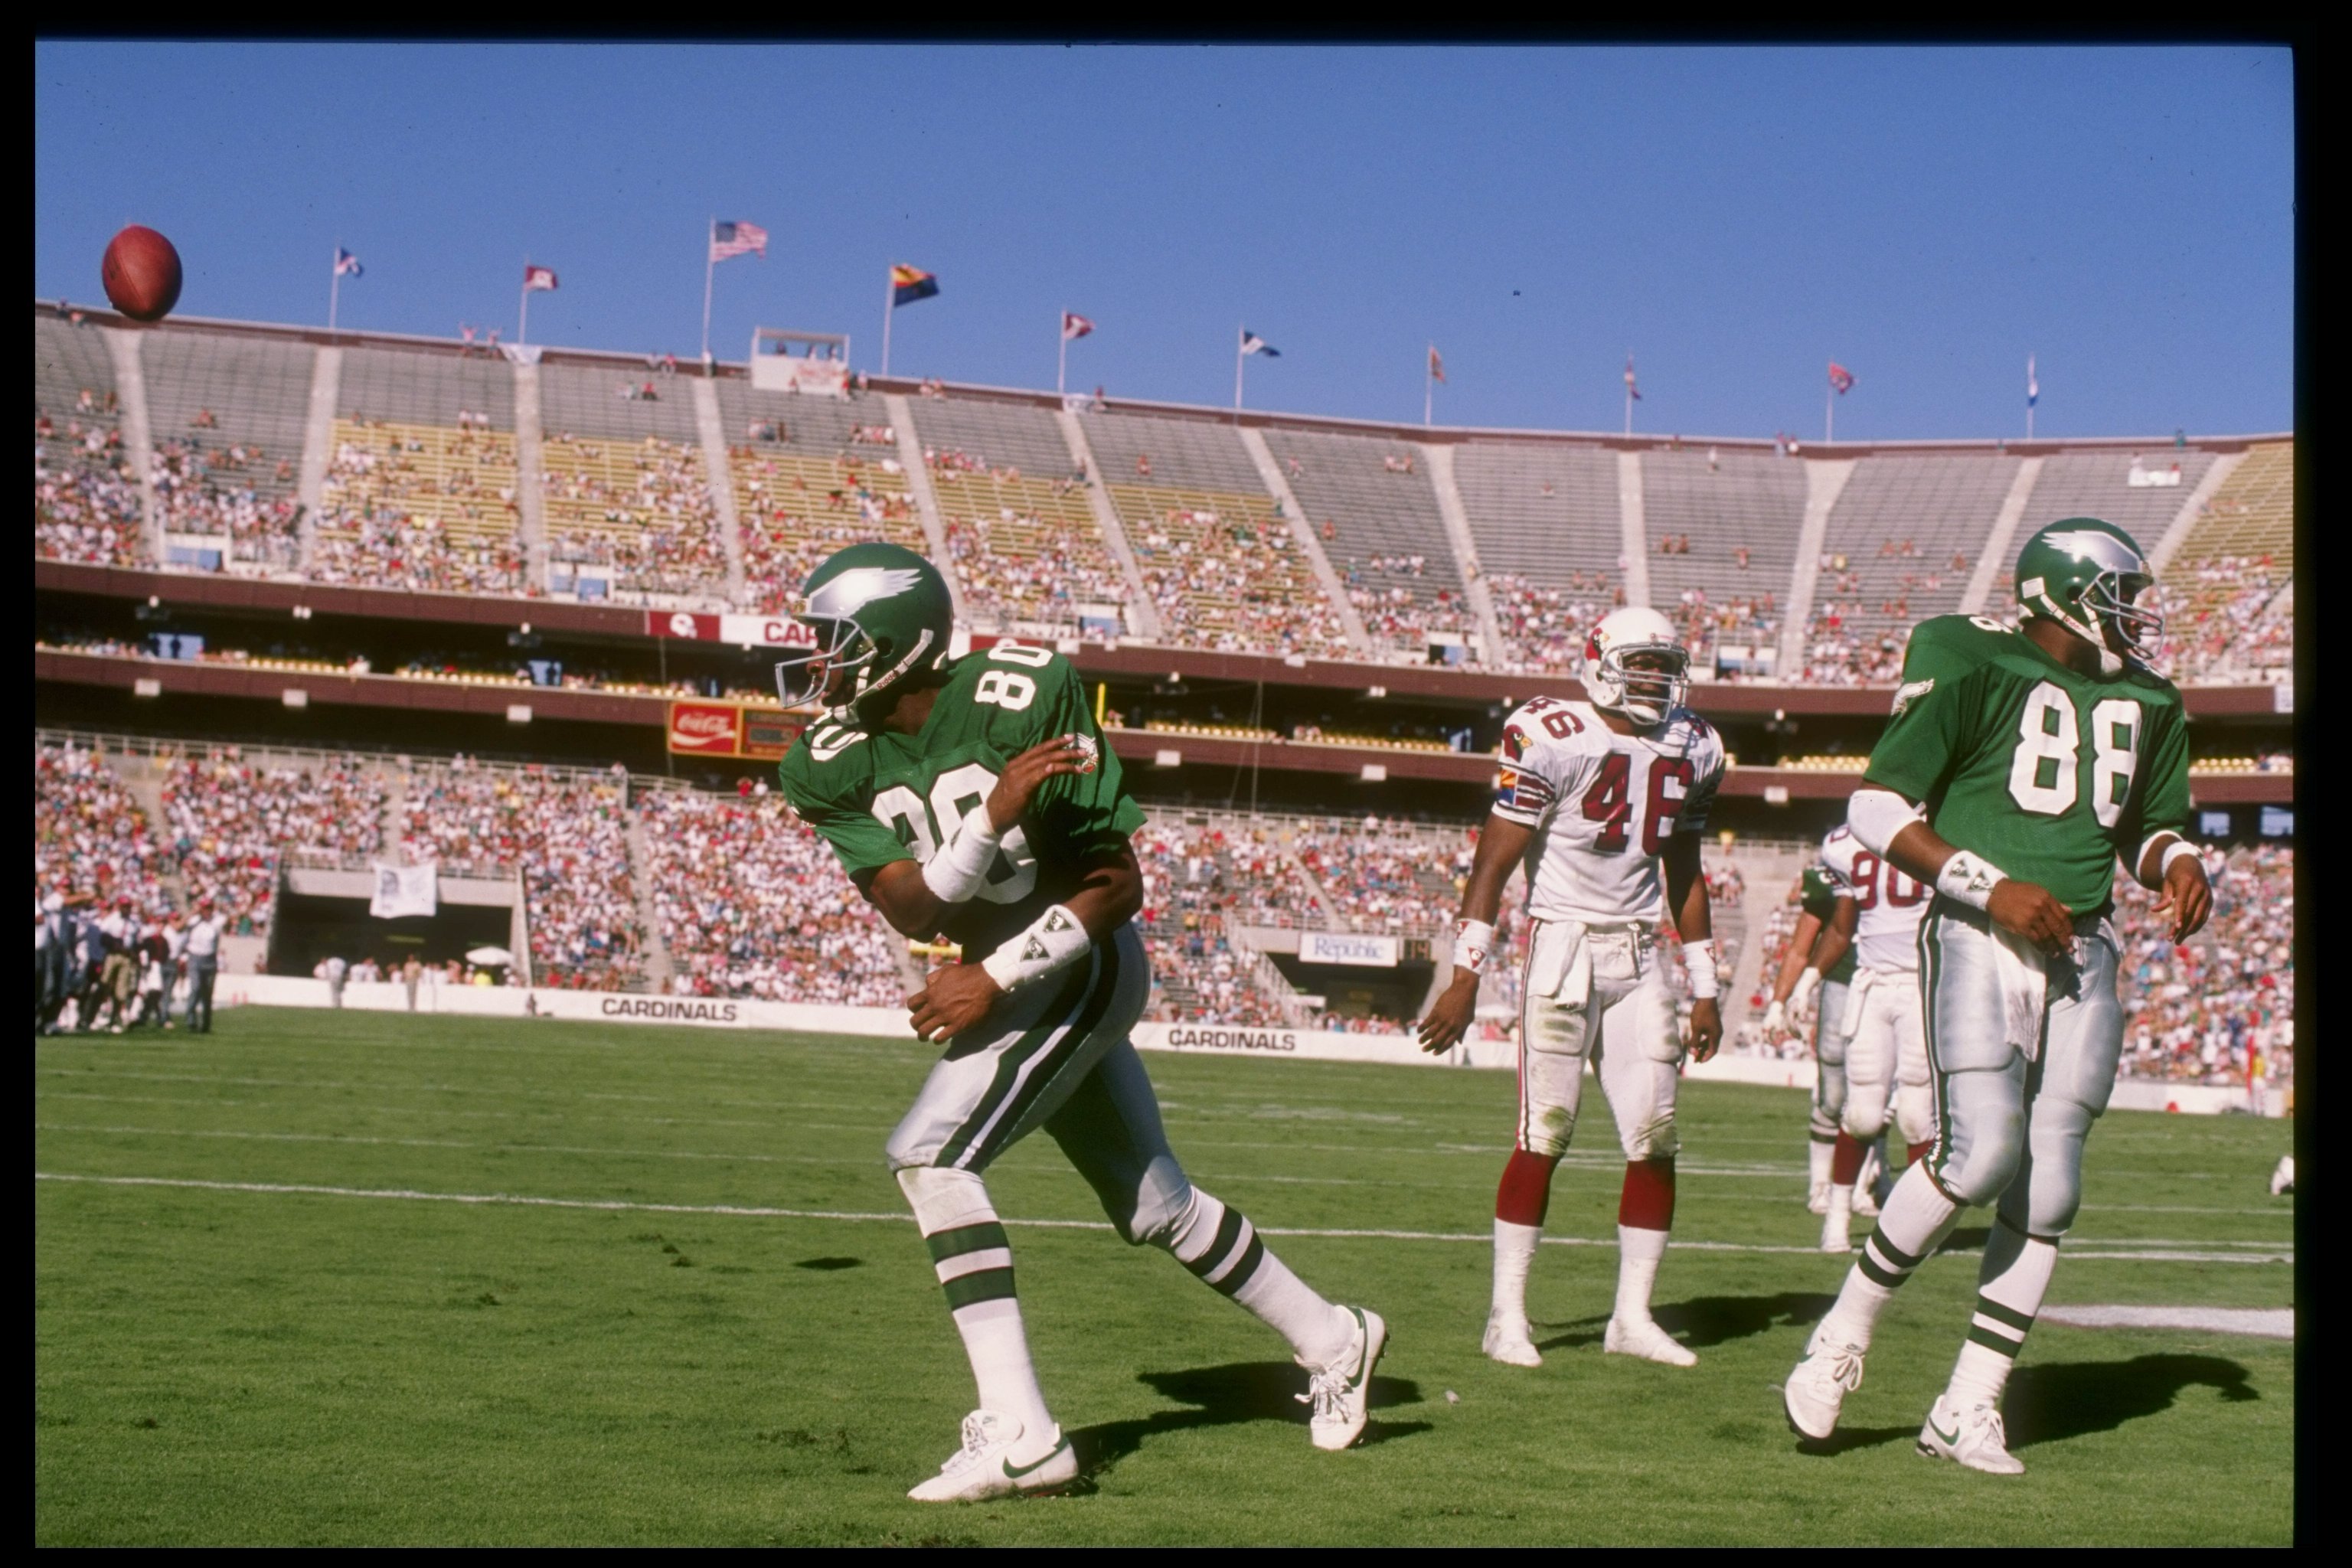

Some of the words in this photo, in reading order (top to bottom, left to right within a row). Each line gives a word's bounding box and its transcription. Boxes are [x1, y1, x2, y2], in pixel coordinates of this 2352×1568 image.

[975, 645, 1054, 710] 80
[2008, 681, 2142, 828] 88
[1582, 753, 1695, 856] 46
[1851, 851, 1924, 910] 90
[1315, 936, 1384, 962] Republic
[603, 998, 737, 1021] CARDINALS
[1169, 1029, 1295, 1050] CARDINALS
